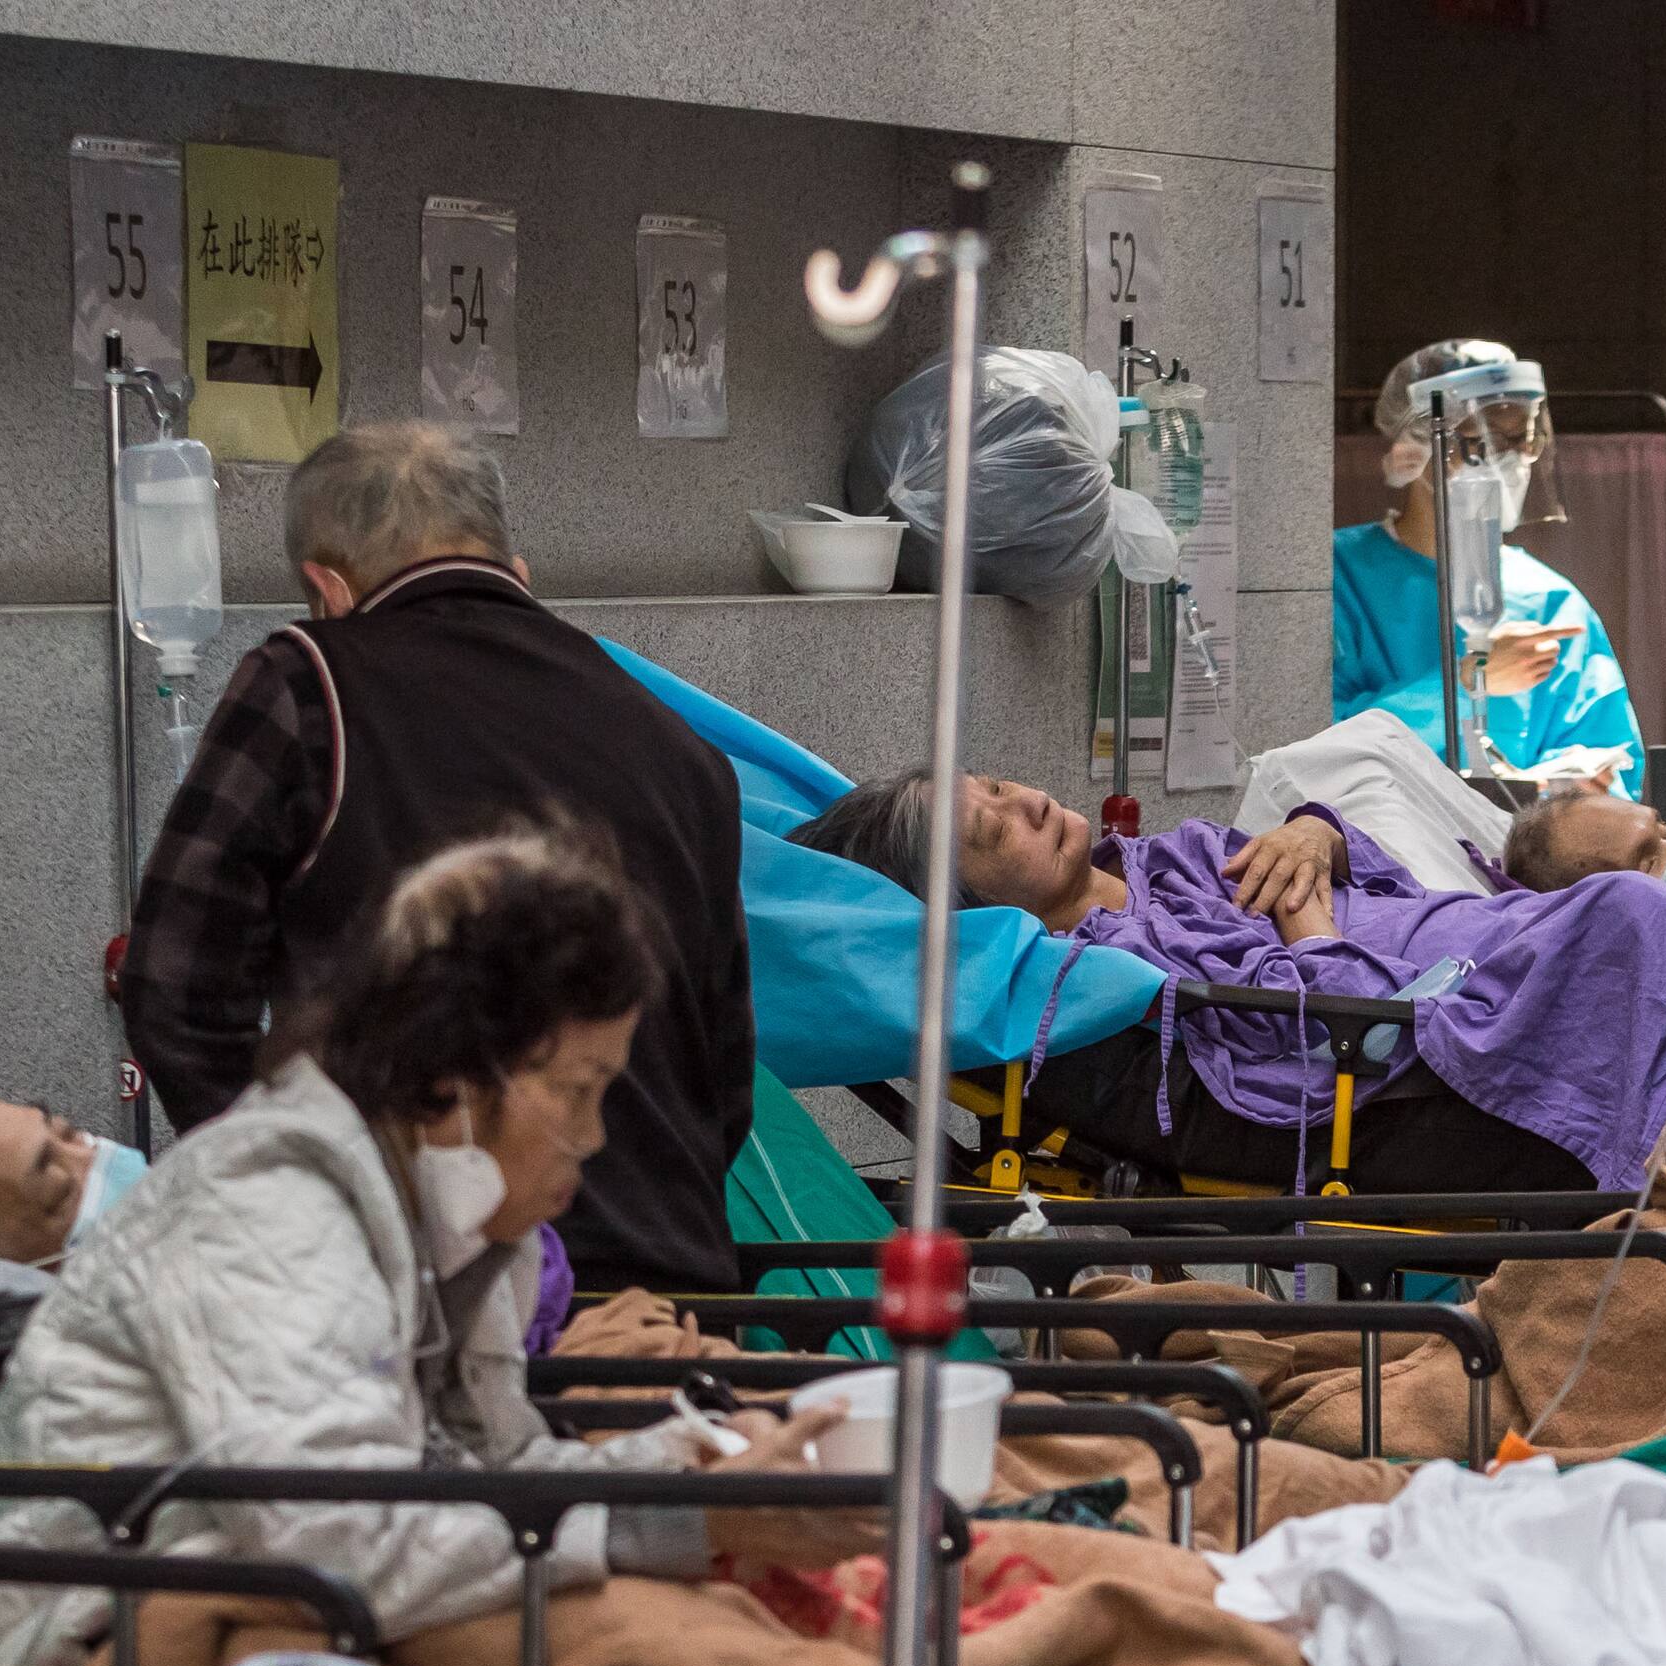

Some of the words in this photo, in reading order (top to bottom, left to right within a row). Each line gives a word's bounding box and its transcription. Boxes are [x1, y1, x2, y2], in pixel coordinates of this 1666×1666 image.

[105, 213, 147, 299] 55
[198, 209, 304, 288] 在此排隊
[1110, 231, 1137, 303] 52
[1280, 240, 1306, 307] 51
[449, 265, 488, 345] 54
[664, 280, 697, 356] 53
